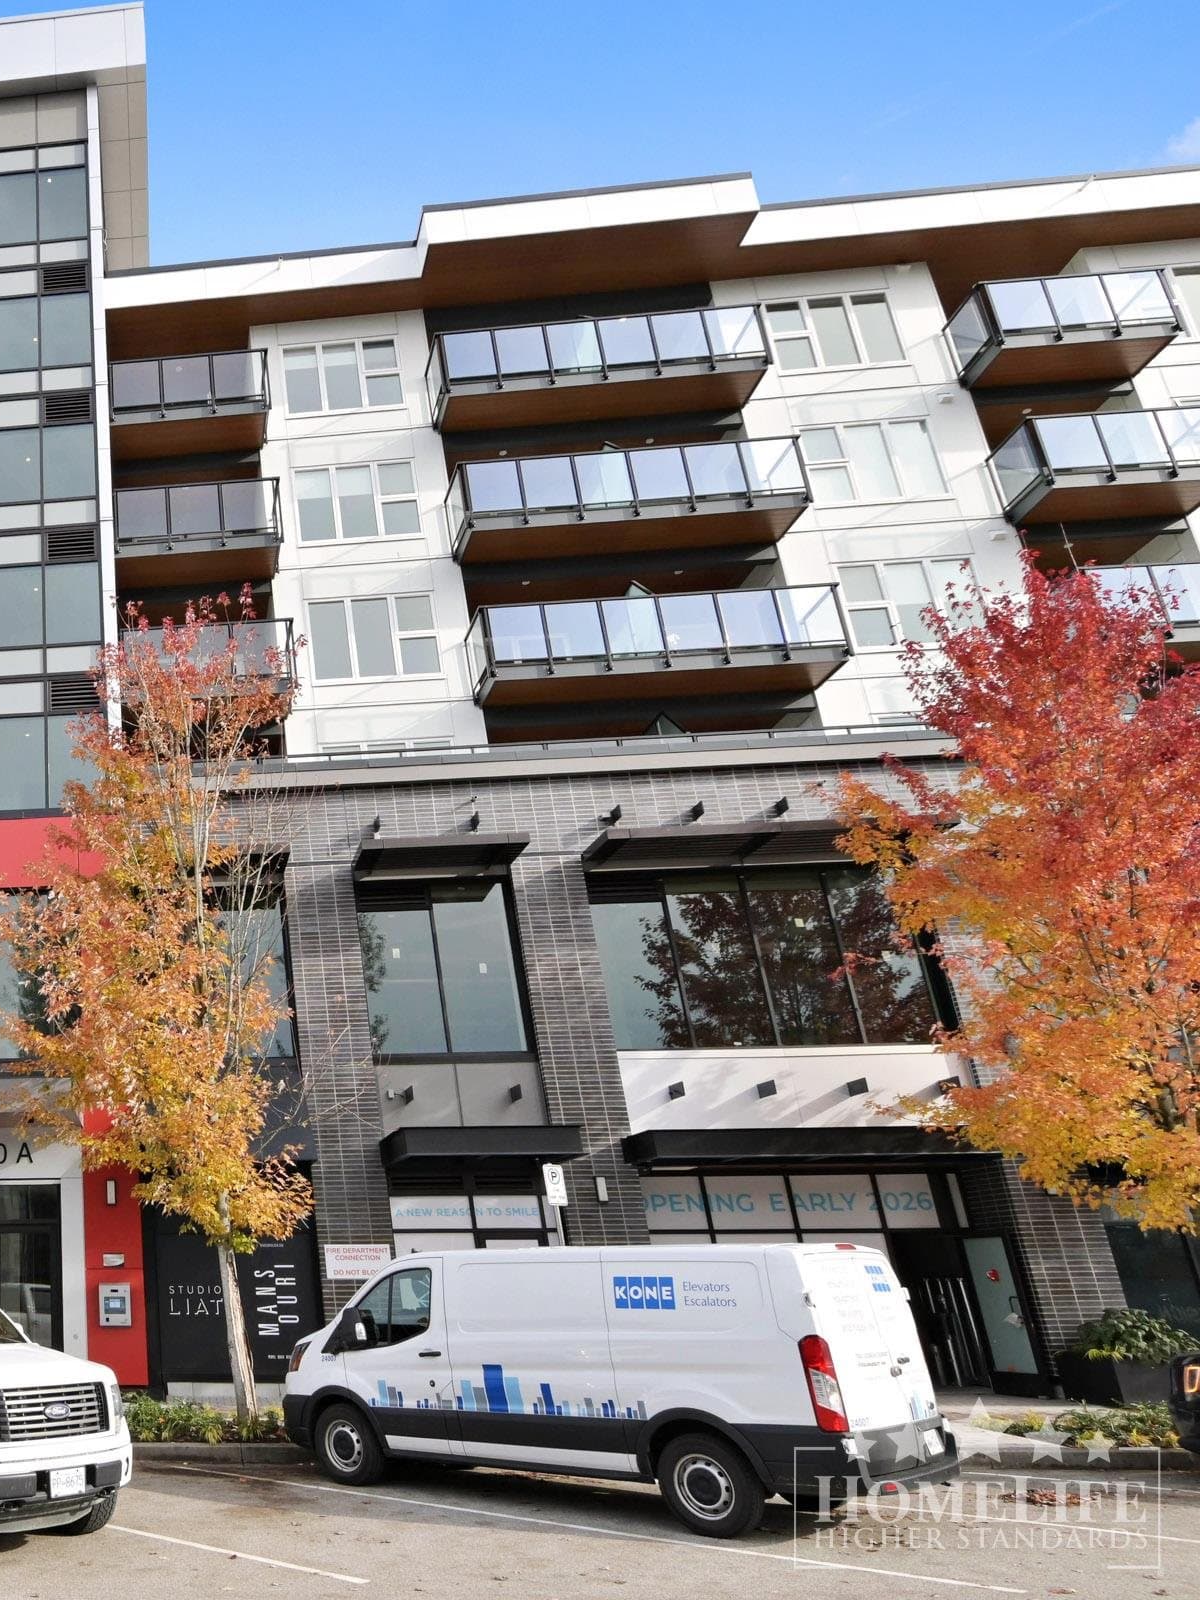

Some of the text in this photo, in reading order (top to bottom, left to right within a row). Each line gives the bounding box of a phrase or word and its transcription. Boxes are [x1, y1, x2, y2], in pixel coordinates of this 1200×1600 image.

[15, 1142, 34, 1164] A
[768, 1191, 857, 1212] EARLY
[865, 1191, 933, 1212] 2026
[395, 1207, 540, 1217] A NEW REASON TO SMILE
[168, 1285, 222, 1295] STUDIO
[274, 1264, 300, 1324] OURI
[614, 1286, 673, 1300] KONE
[682, 1281, 730, 1293] Elevators
[253, 1269, 280, 1336] MANS
[684, 1295, 737, 1307] Escalators
